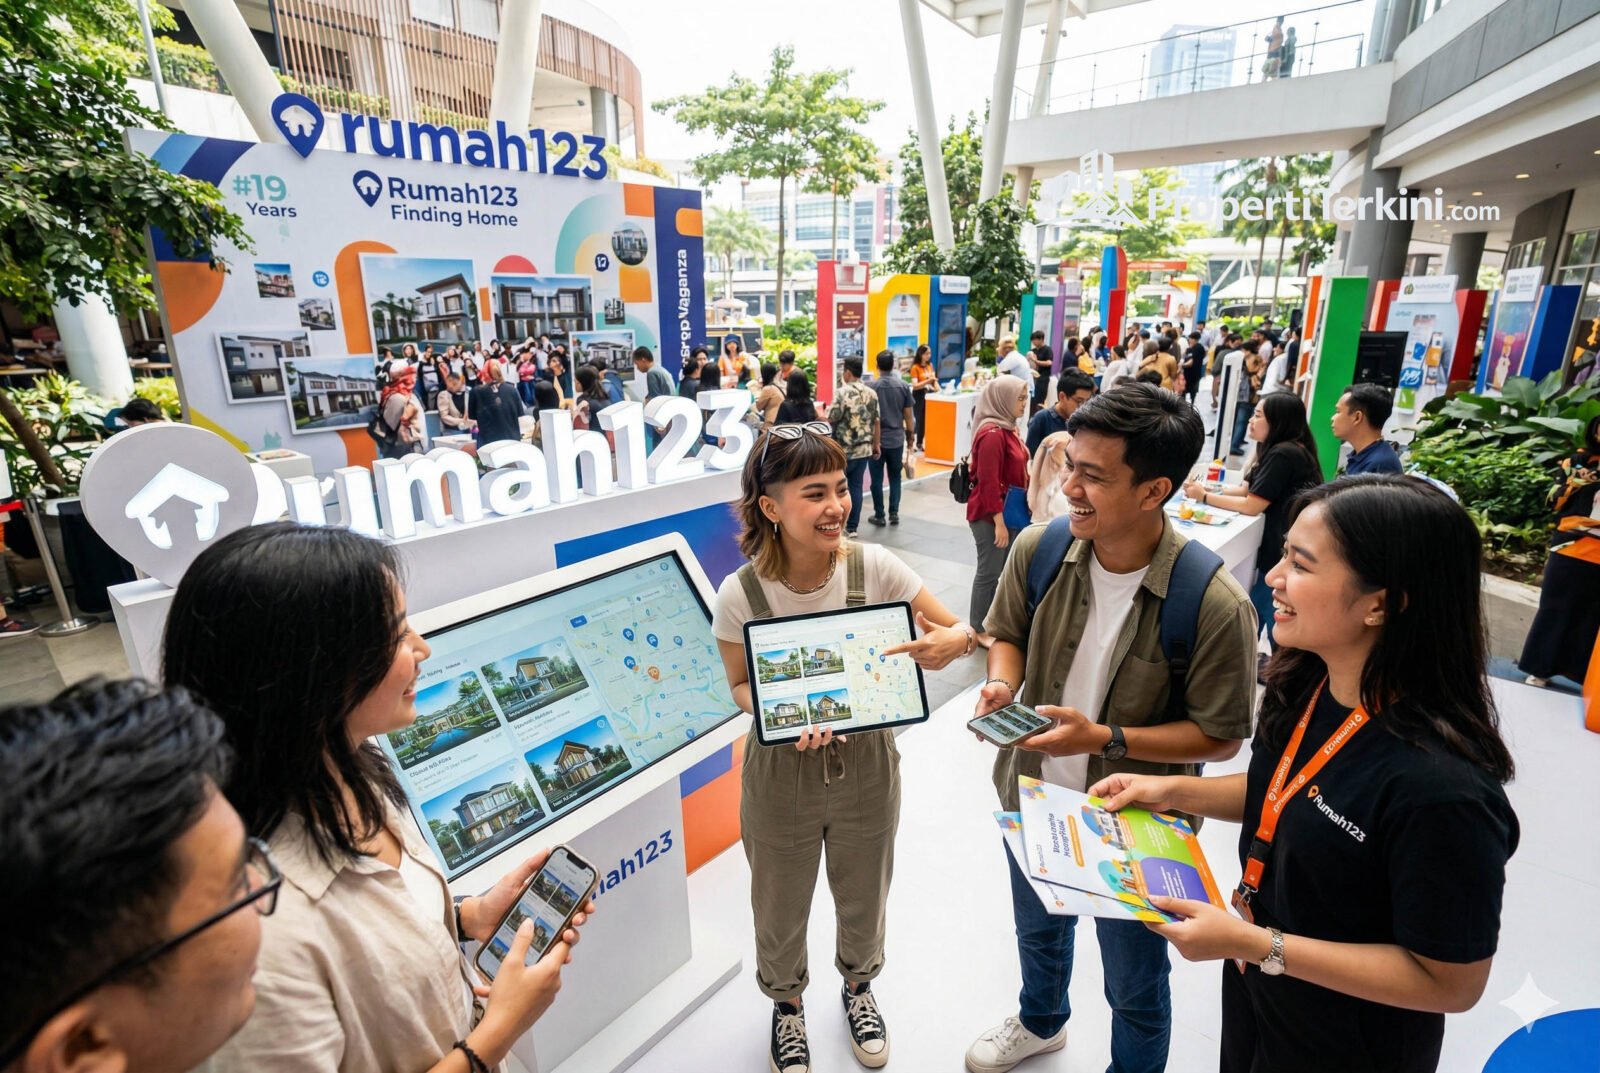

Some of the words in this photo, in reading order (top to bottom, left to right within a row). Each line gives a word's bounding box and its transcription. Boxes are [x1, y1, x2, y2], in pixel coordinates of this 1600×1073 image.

[341, 113, 607, 180] rumah123
[233, 174, 287, 202] #19
[388, 176, 518, 207] Rumah123
[246, 202, 297, 218] Years
[391, 204, 463, 226] Finding
[468, 210, 518, 226] Home
[1313, 794, 1367, 843] Rumah123
